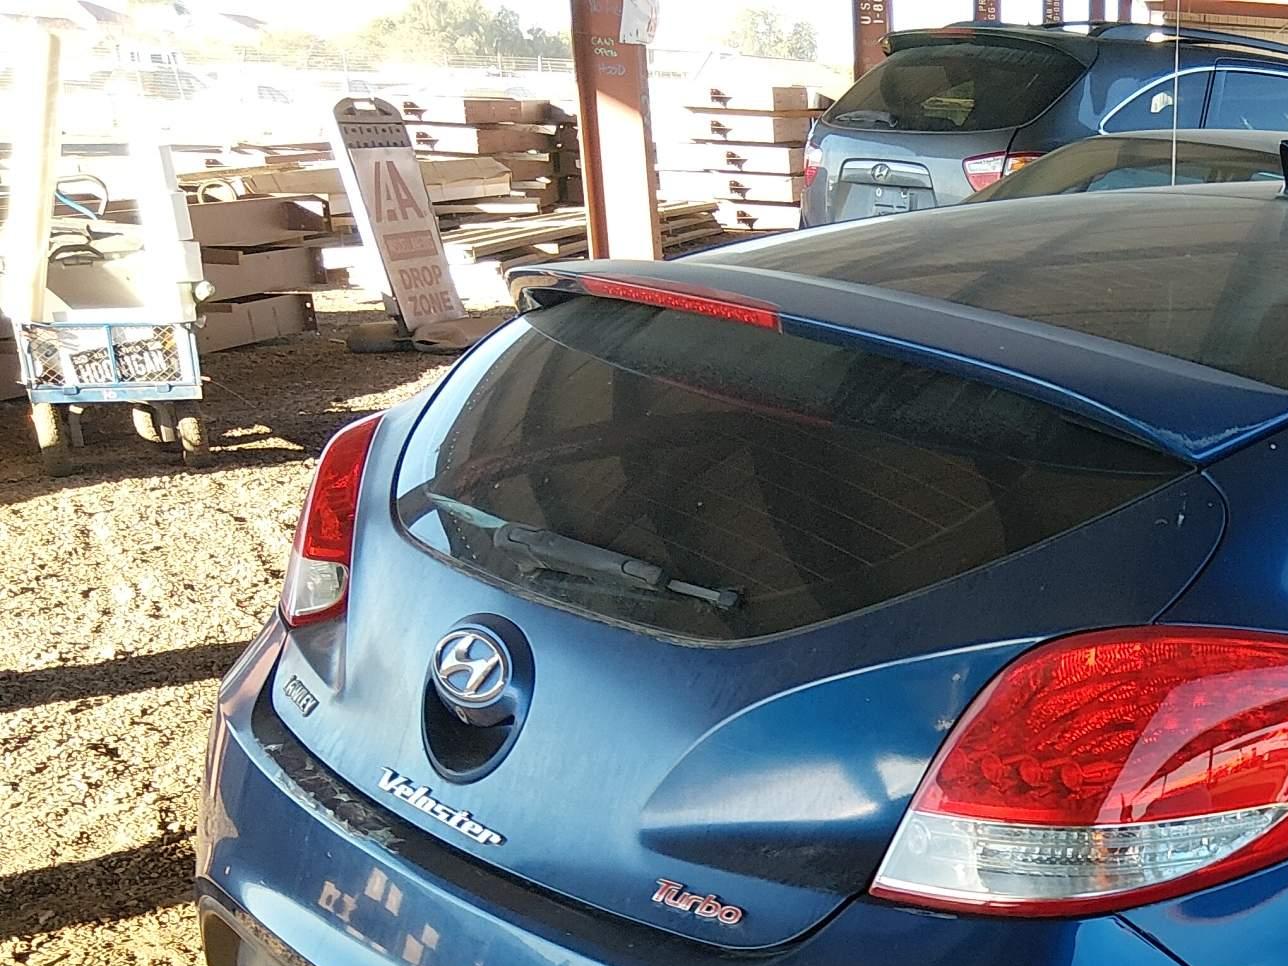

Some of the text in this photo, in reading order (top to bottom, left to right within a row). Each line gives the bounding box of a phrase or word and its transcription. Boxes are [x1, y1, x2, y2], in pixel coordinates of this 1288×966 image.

[398, 264, 442, 290] DROP
[407, 290, 455, 317] ZONE
[77, 349, 167, 384] HOOIGAN
[377, 765, 506, 846] Veloster
[651, 877, 744, 925] Turbo
